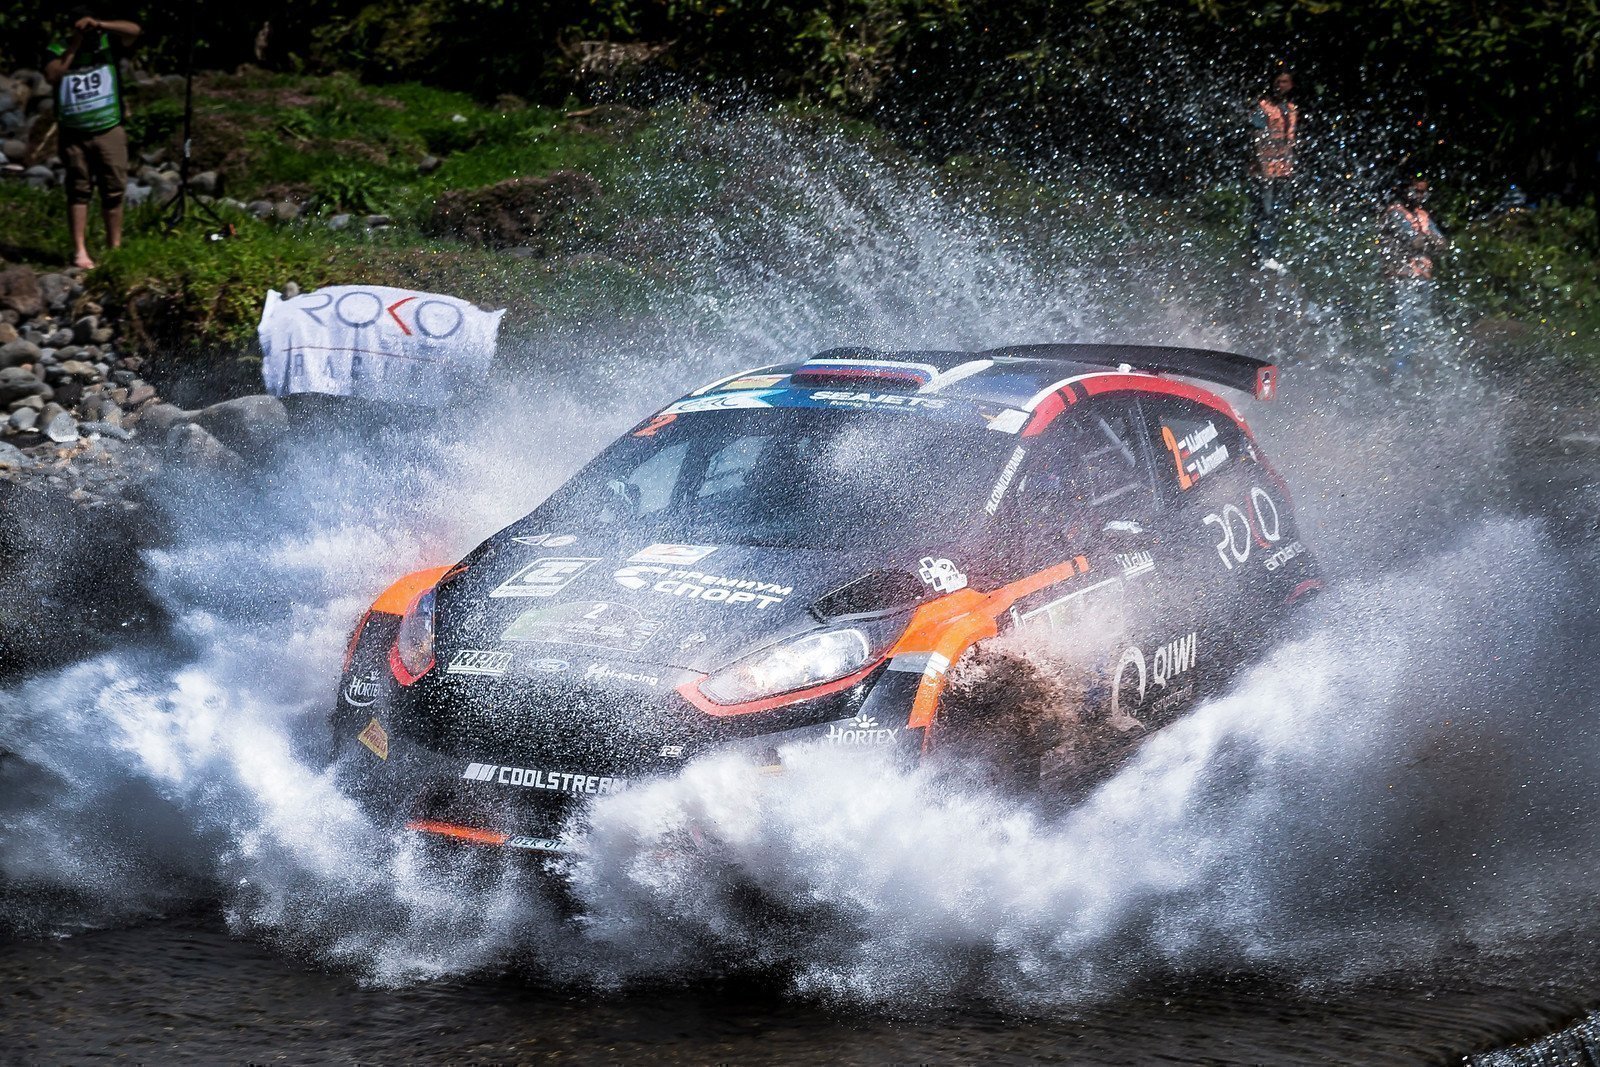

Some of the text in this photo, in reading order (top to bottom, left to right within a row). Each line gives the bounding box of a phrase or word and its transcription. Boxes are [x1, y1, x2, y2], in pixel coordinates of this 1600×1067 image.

[72, 73, 101, 94] 219
[1161, 426, 1193, 491] 2
[654, 580, 783, 609] СПОРТ
[668, 570, 793, 596] ПРЕМИУМ
[1153, 631, 1197, 689] QIWI
